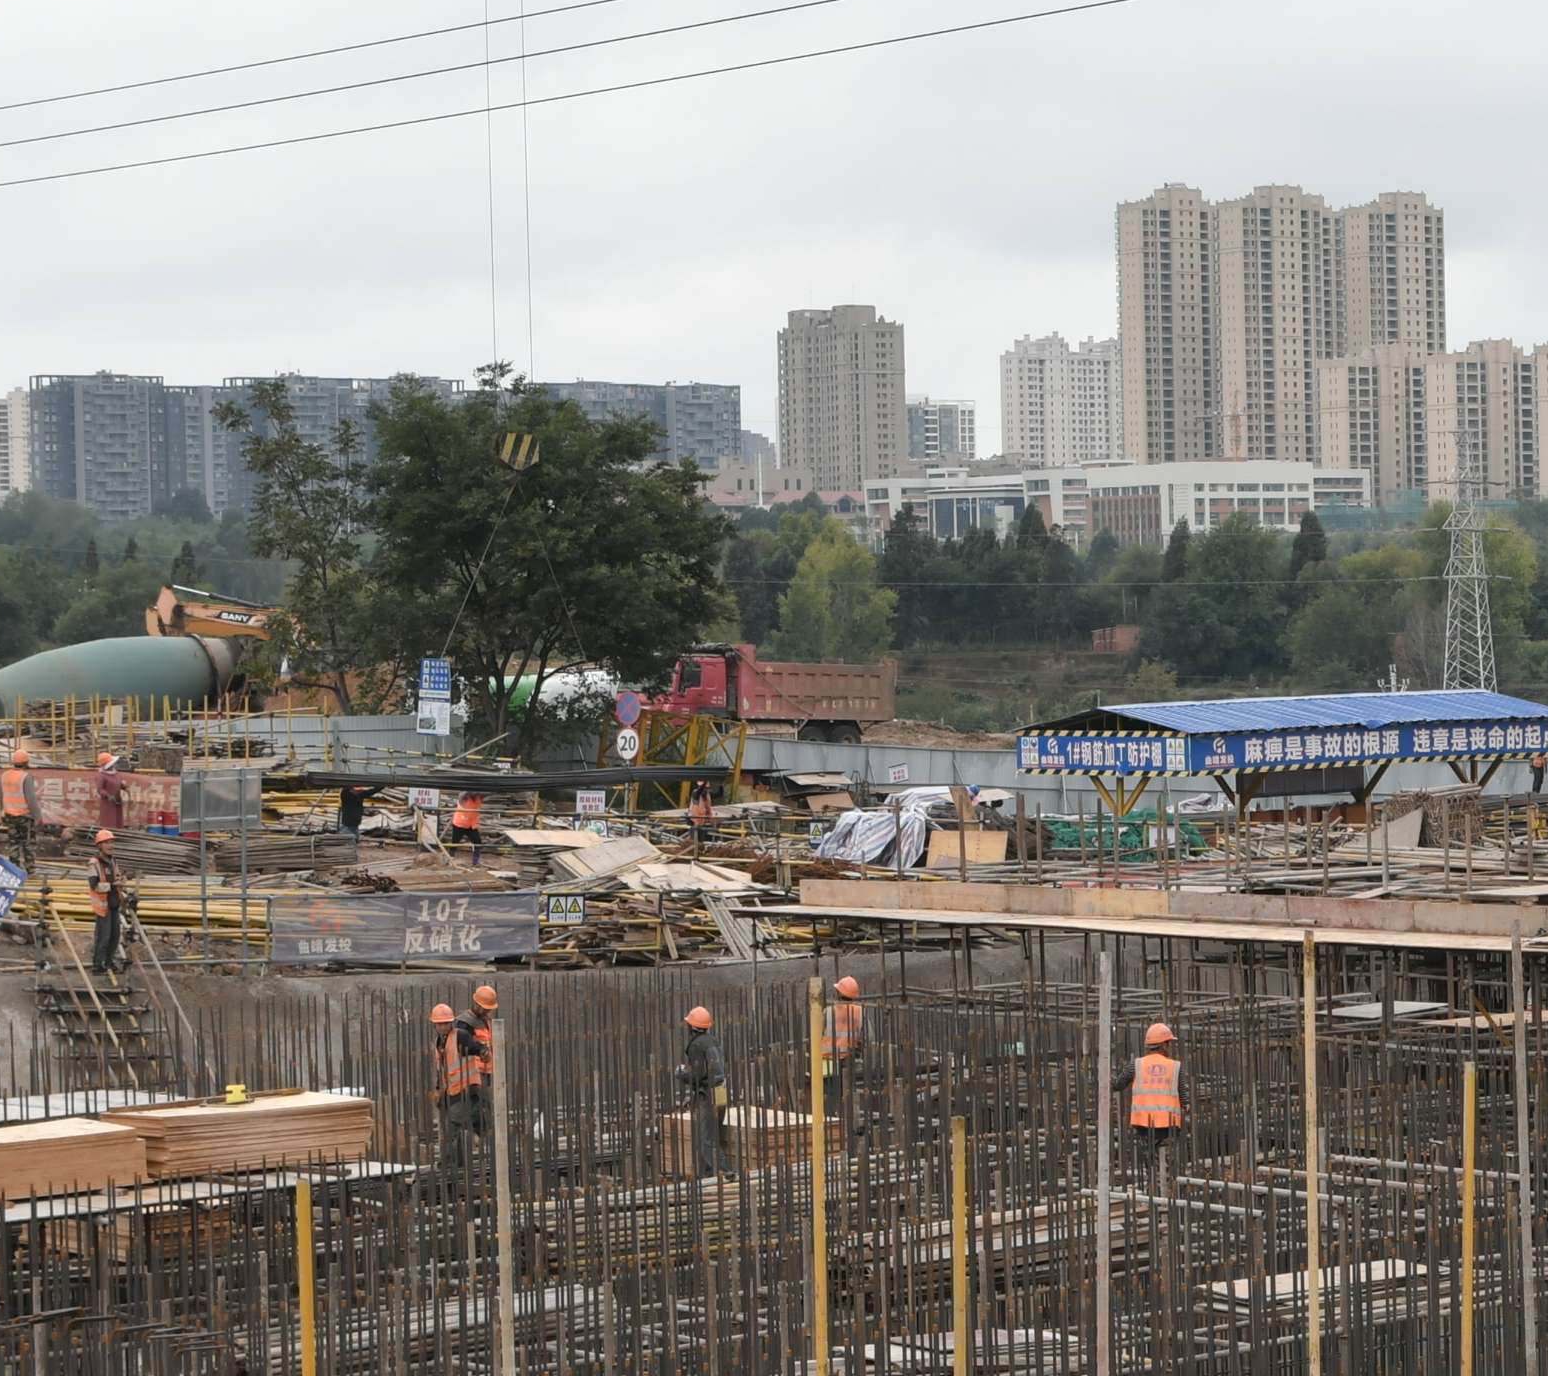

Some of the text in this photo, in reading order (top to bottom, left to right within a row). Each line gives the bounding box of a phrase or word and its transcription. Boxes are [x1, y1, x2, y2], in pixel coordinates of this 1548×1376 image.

[221, 612, 249, 622] SANY
[619, 735, 637, 752] 20
[1244, 730, 1400, 764] 麻痹是事故的根源
[417, 897, 471, 923] 107
[297, 938, 354, 956] 曲靖发投
[403, 925, 481, 955] 反硝化
